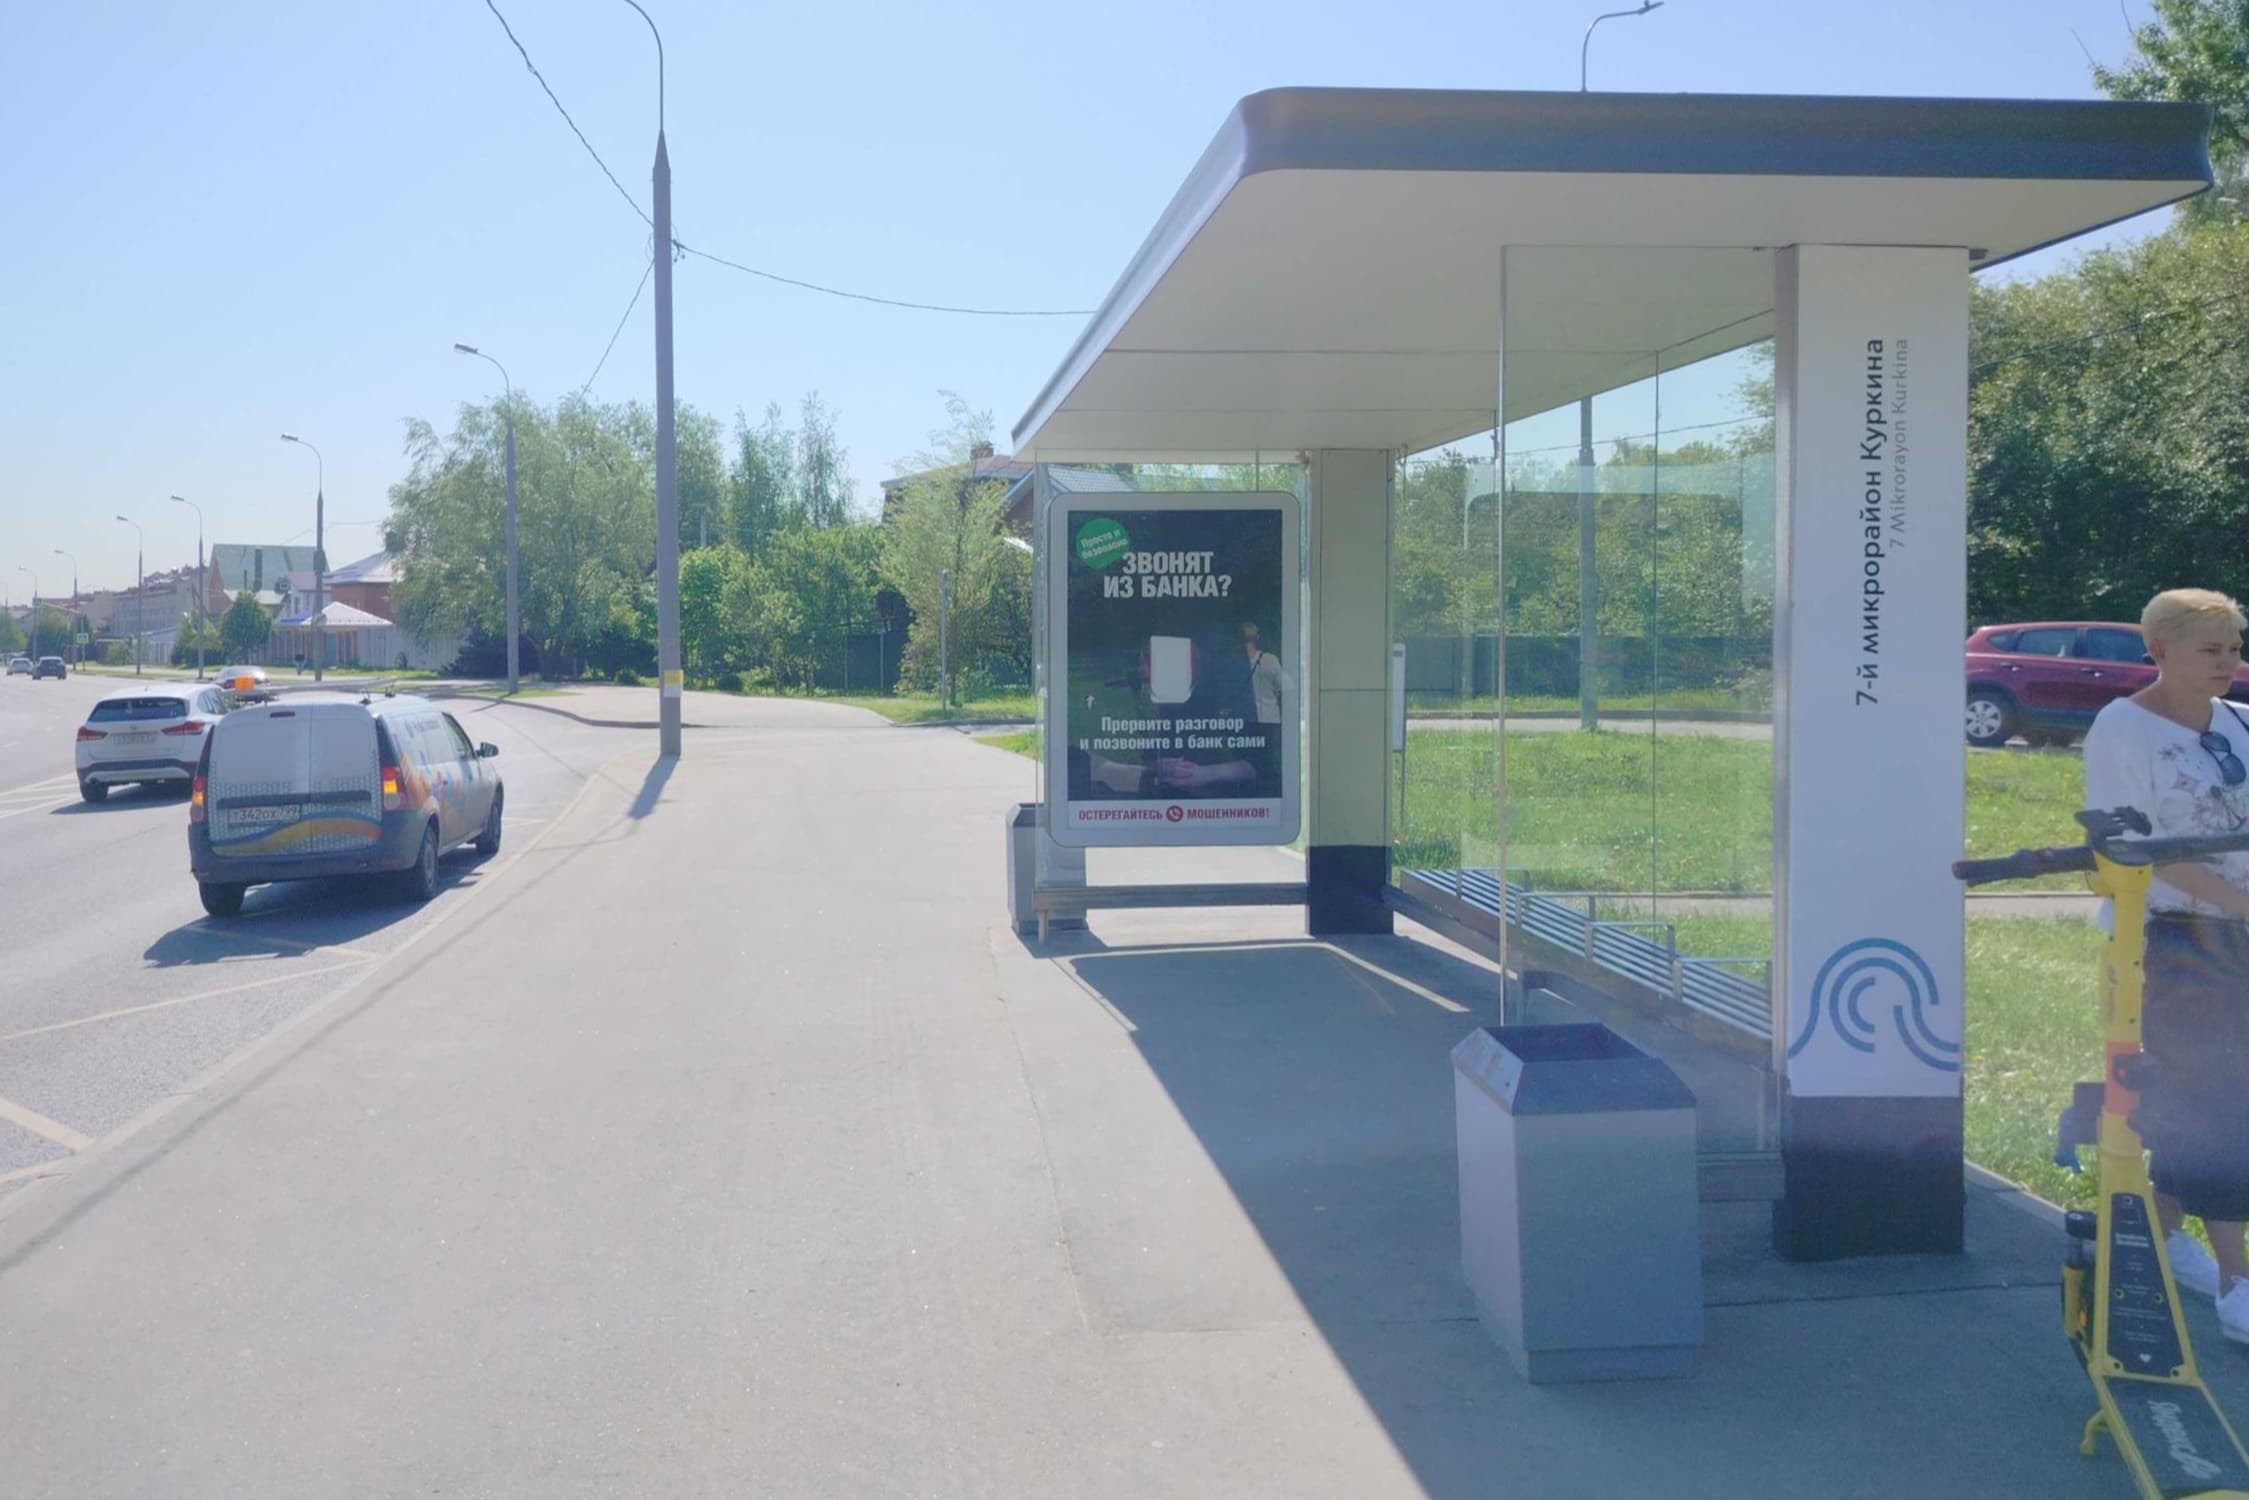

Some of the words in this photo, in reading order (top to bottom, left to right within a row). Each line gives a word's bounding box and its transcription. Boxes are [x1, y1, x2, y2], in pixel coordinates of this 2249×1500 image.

[1891, 338, 1909, 414] Kurkina
[1860, 338, 1888, 460] Куркина
[1889, 422, 1910, 532] Mikrorayon
[1889, 538, 1905, 548] 7
[1122, 551, 1214, 576] ЗВОНЯТ
[1859, 471, 1885, 654] микрорайон
[1103, 575, 1134, 599] ИЗ
[1141, 574, 1233, 598] БАНКА?
[1856, 665, 1879, 706] 7-й
[1101, 716, 1171, 733] Прервите
[1175, 717, 1244, 734] разговор
[1079, 737, 1089, 750] и
[1093, 736, 1170, 751] позвоните
[1174, 737, 1184, 749] в
[1187, 735, 1222, 749] банк
[1227, 736, 1266, 748] сами
[1078, 806, 1163, 821] ОСТЕРЕГАЙТЕСЬ
[1187, 806, 1270, 820] МОШЕННИКОВ!
